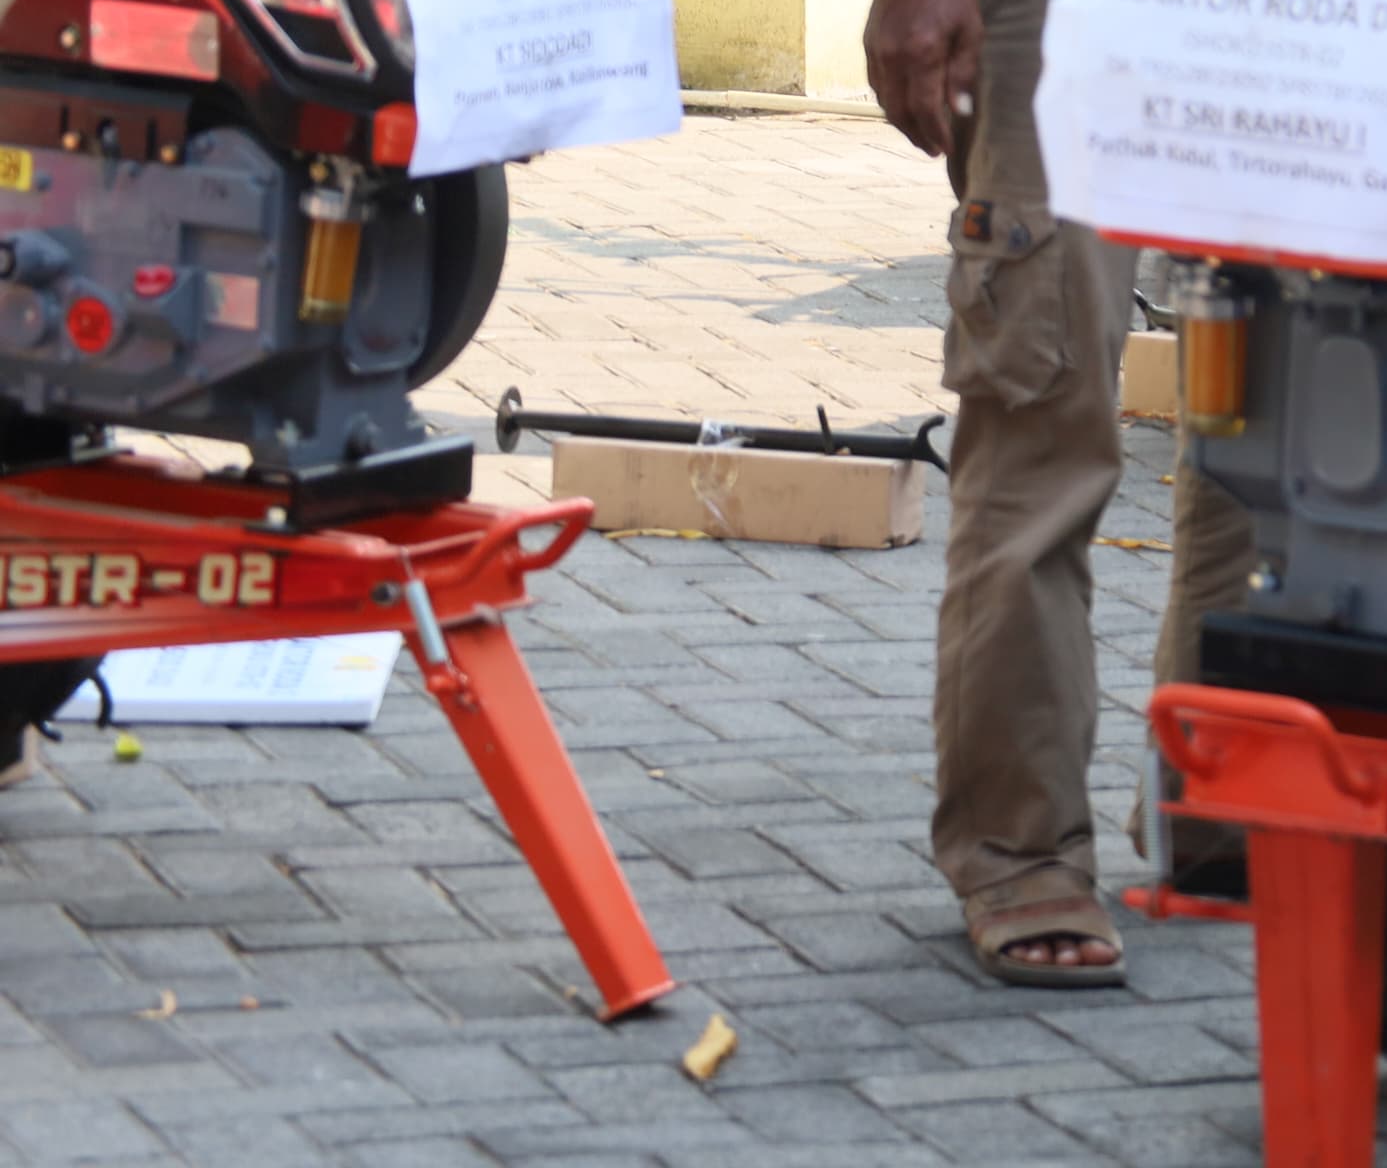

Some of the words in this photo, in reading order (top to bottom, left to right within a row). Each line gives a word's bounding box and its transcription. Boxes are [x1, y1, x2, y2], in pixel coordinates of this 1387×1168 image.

[1142, 95, 1175, 120] KT
[1183, 100, 1224, 129] SRI
[1232, 107, 1349, 146] RAHAYU
[0, 553, 274, 604] STR-02
